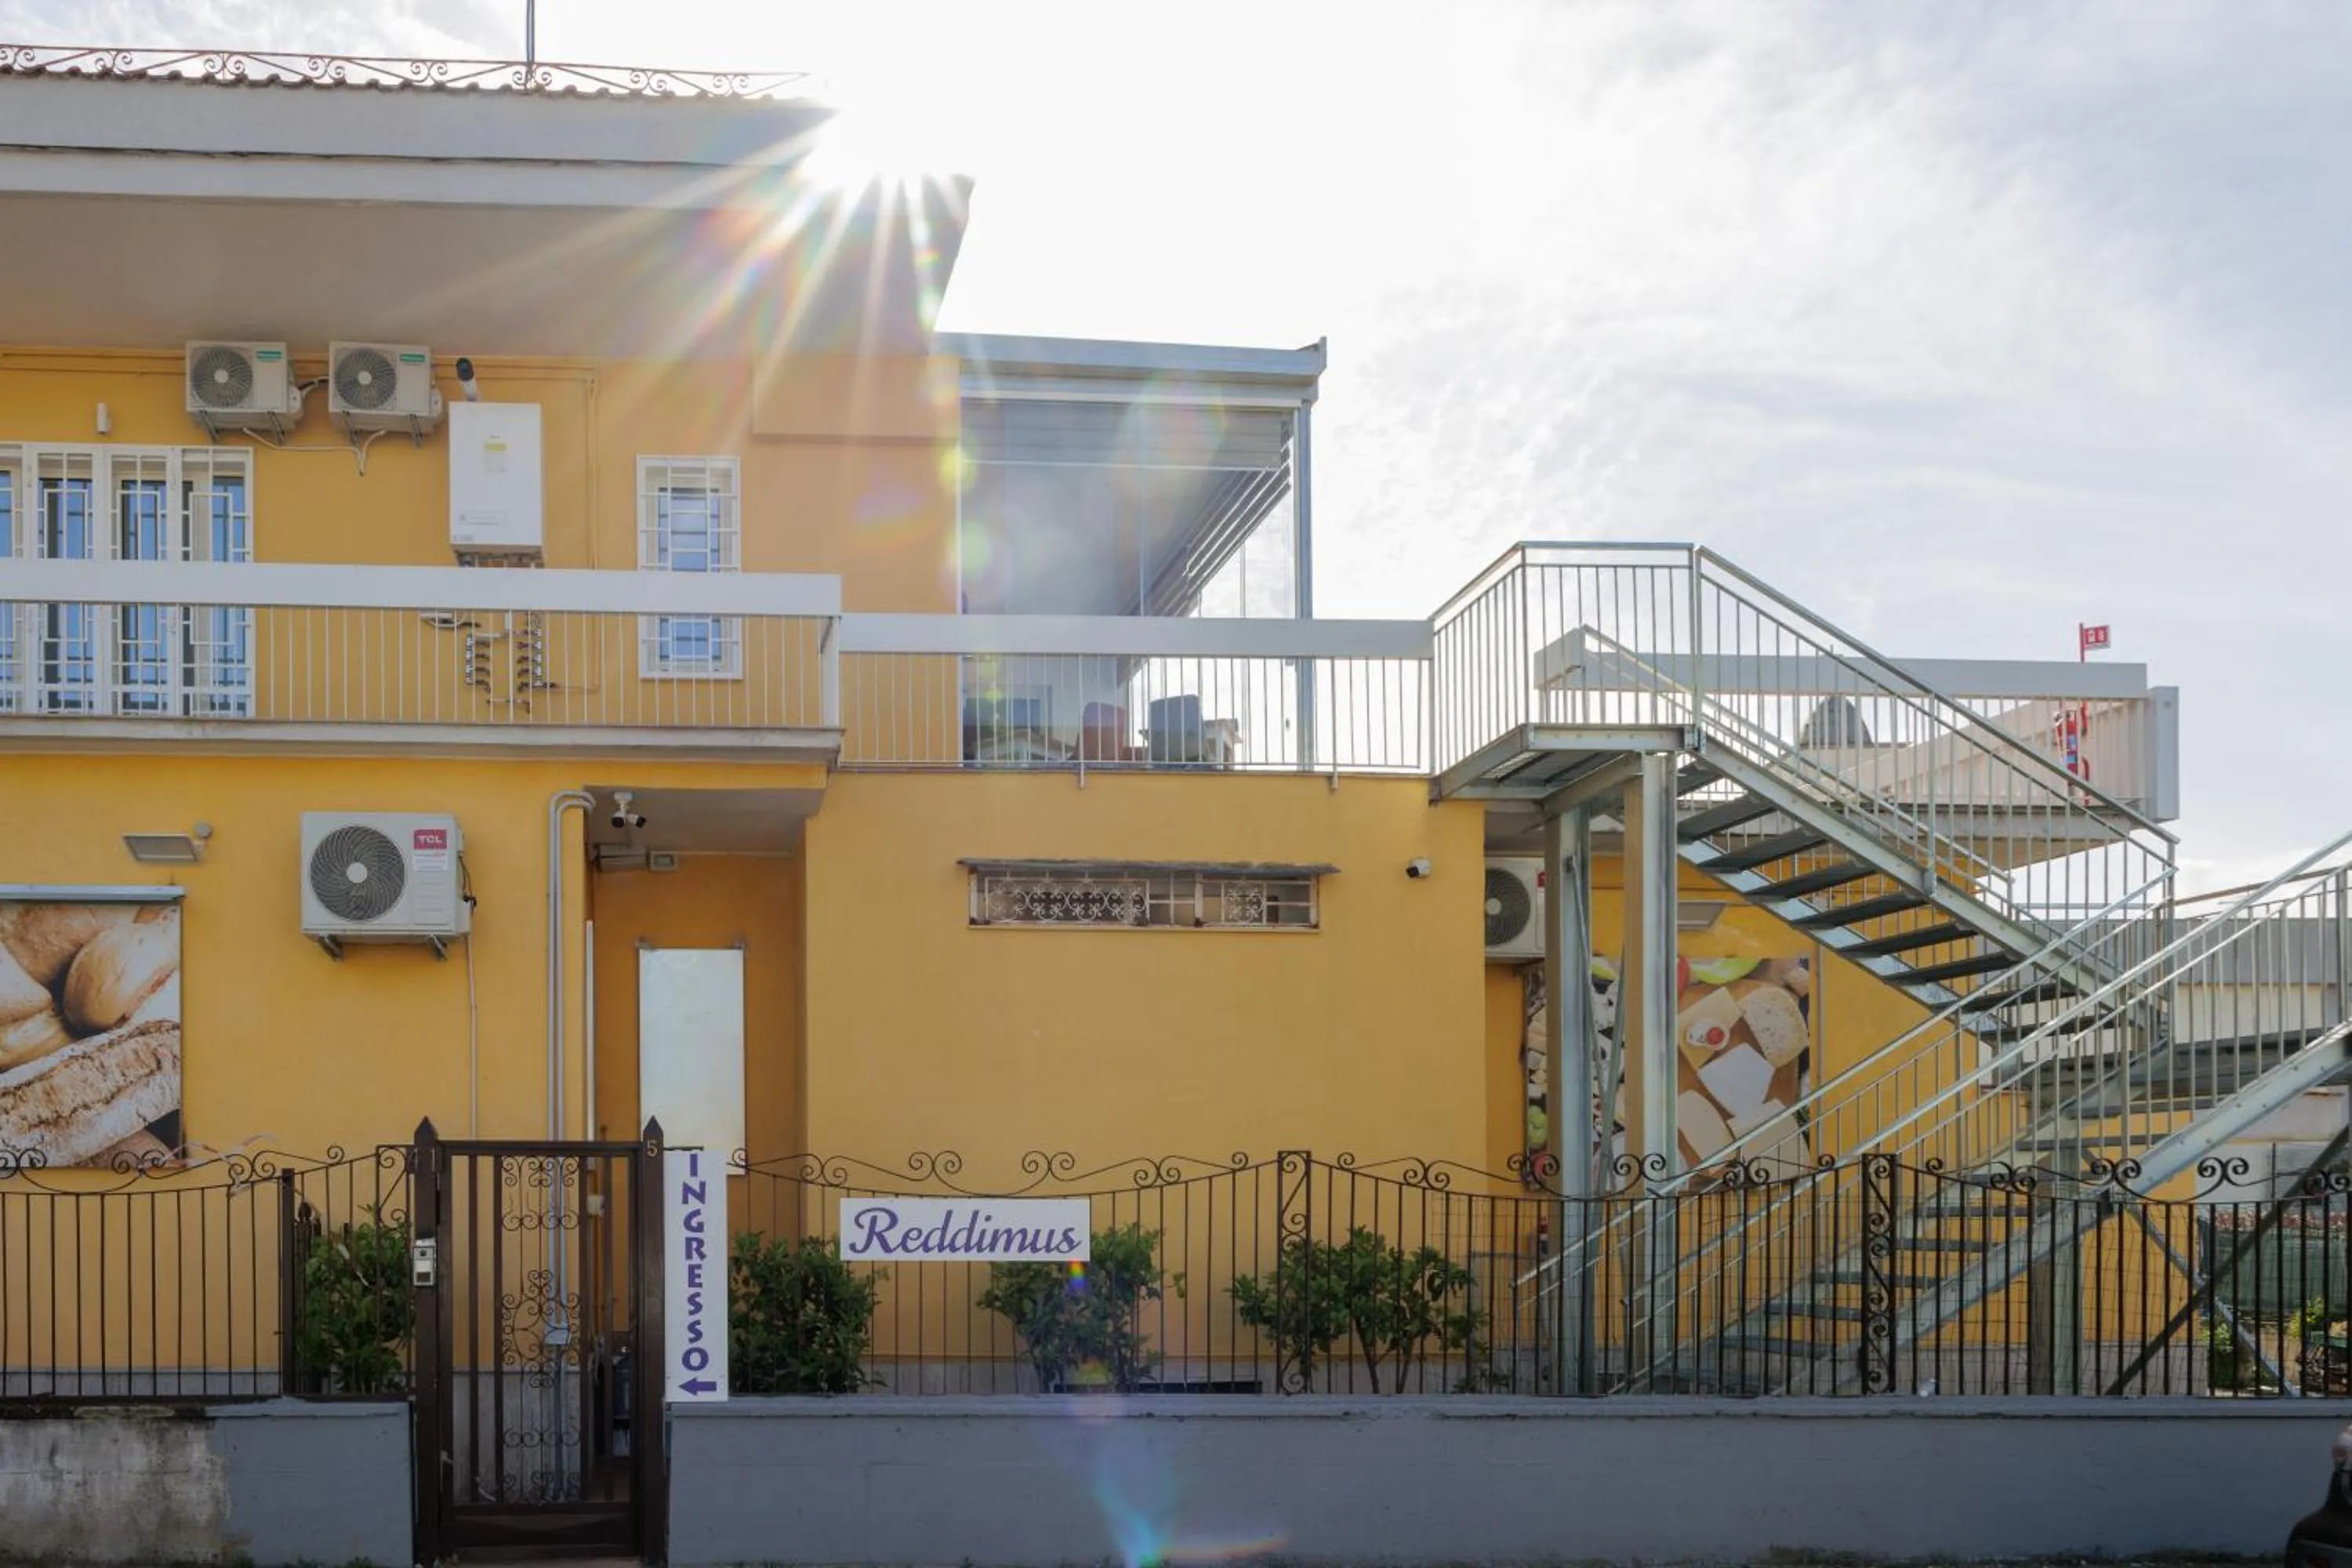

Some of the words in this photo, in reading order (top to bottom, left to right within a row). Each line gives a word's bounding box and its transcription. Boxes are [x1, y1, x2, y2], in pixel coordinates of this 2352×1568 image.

[416, 835, 442, 844] TCL
[647, 1138, 658, 1157] 5
[848, 1207, 1082, 1254] Reddimus
[681, 1153, 710, 1371] INGRESSO
